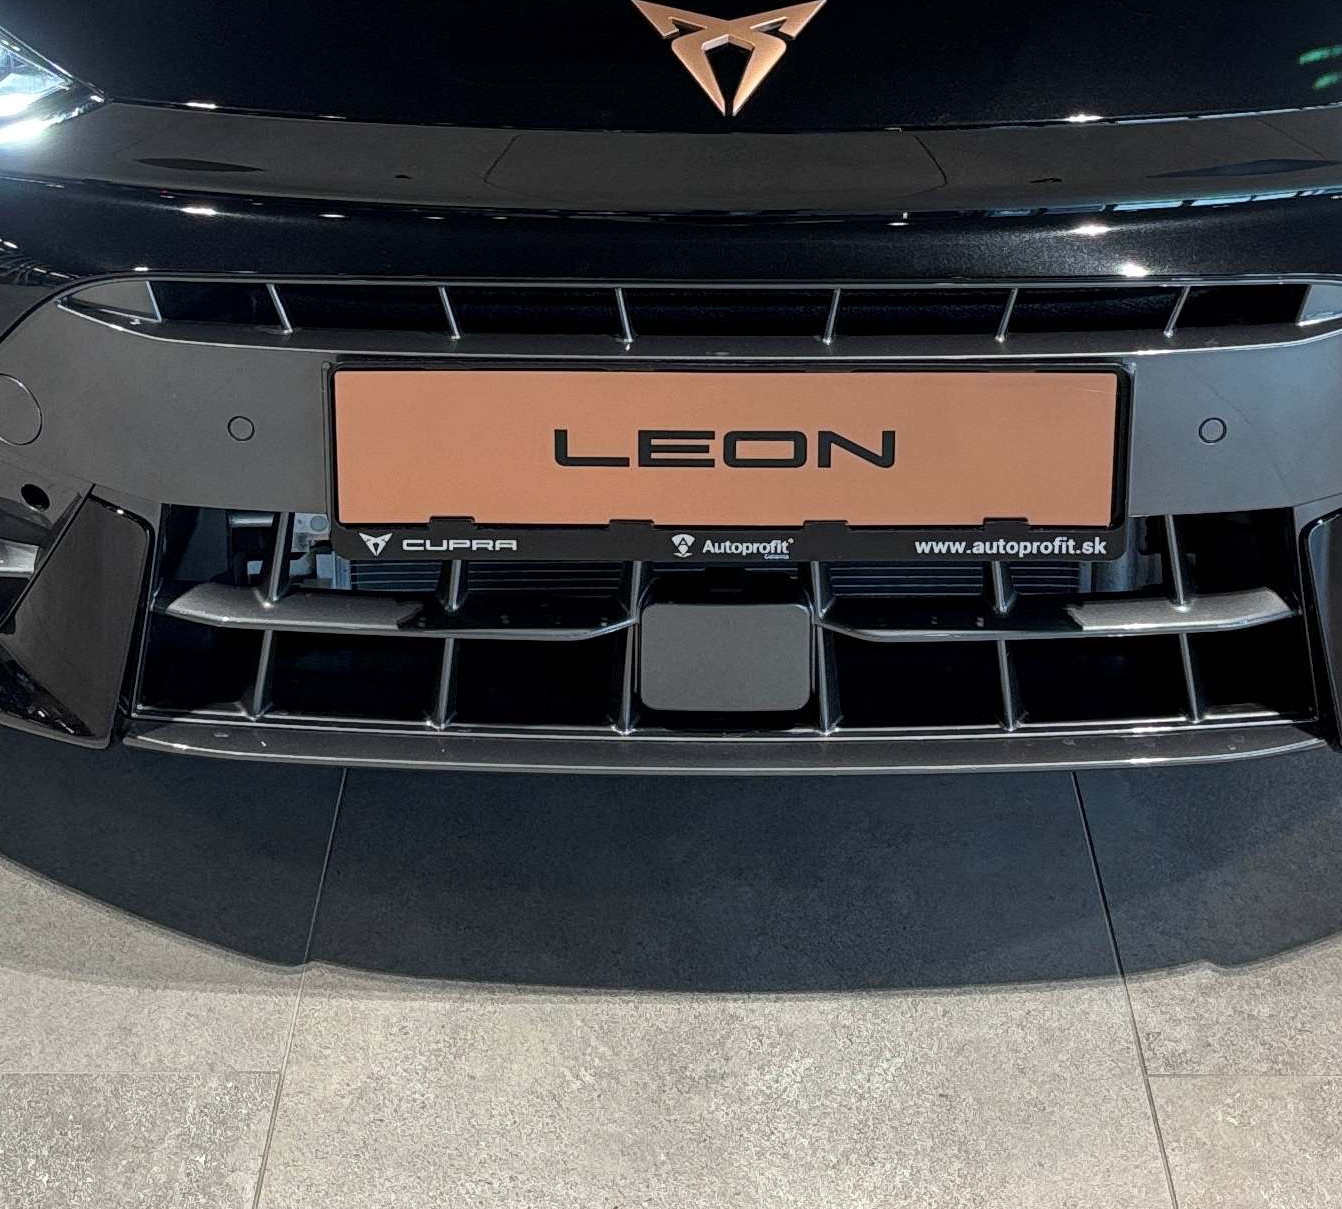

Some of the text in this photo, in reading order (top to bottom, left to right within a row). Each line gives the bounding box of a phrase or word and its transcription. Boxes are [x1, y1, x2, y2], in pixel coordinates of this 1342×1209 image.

[554, 429, 896, 468] LEON
[402, 539, 518, 551] CUPRA
[702, 539, 790, 556] Autoprofit
[914, 537, 1107, 558] www.autoprofit.sk
